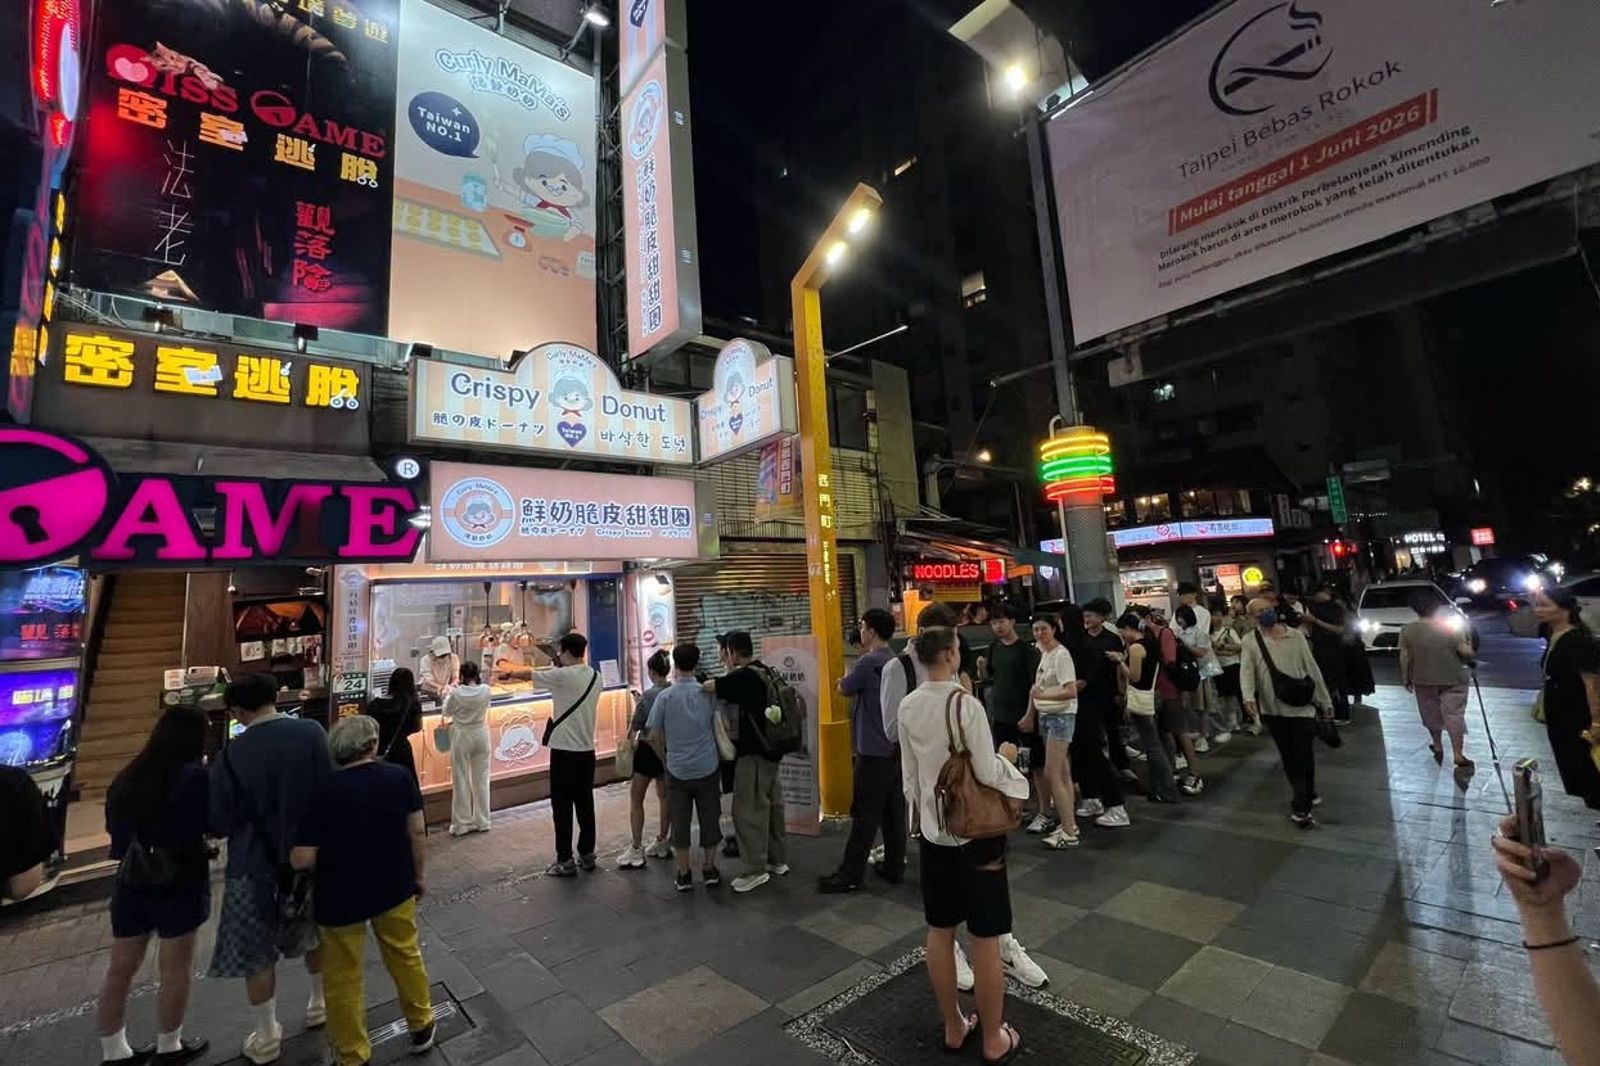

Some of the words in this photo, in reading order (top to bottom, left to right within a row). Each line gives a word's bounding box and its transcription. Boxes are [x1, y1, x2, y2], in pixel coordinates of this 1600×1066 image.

[417, 104, 471, 134] Taiwan
[426, 123, 463, 143] NO.1
[1177, 138, 1237, 177] Taipei
[1243, 106, 1312, 147] Bebas
[1319, 61, 1402, 110] Rokok
[1180, 193, 1223, 224] Mulai
[1228, 160, 1294, 201] tanggal
[1301, 155, 1311, 170] 1
[1317, 131, 1360, 162] Juni
[1366, 105, 1419, 140] 2026
[1158, 251, 1197, 271] Merokok
[1200, 237, 1228, 256] harus
[1231, 231, 1241, 242] di
[1244, 222, 1267, 238] area
[1270, 200, 1321, 226] merokok
[1325, 187, 1355, 207] yang
[1359, 171, 1393, 191] telah
[1397, 137, 1480, 175] ditentukan
[1160, 237, 1199, 259] Dilarang
[1201, 216, 1246, 241] merokok
[1248, 209, 1259, 222] di
[1262, 195, 1299, 217] Distrik
[1302, 159, 1387, 199] Perbelanjaan
[1390, 125, 1472, 164] Ximending
[64, 333, 360, 409] 密室逃脫
[451, 373, 540, 410] Crispy
[603, 395, 666, 422] Donut
[522, 499, 690, 527] 鮮奶脆皮甜甜圈
[818, 473, 831, 528] 西門町
[914, 563, 979, 579] NOODLES
[344, 679, 363, 691] 24
